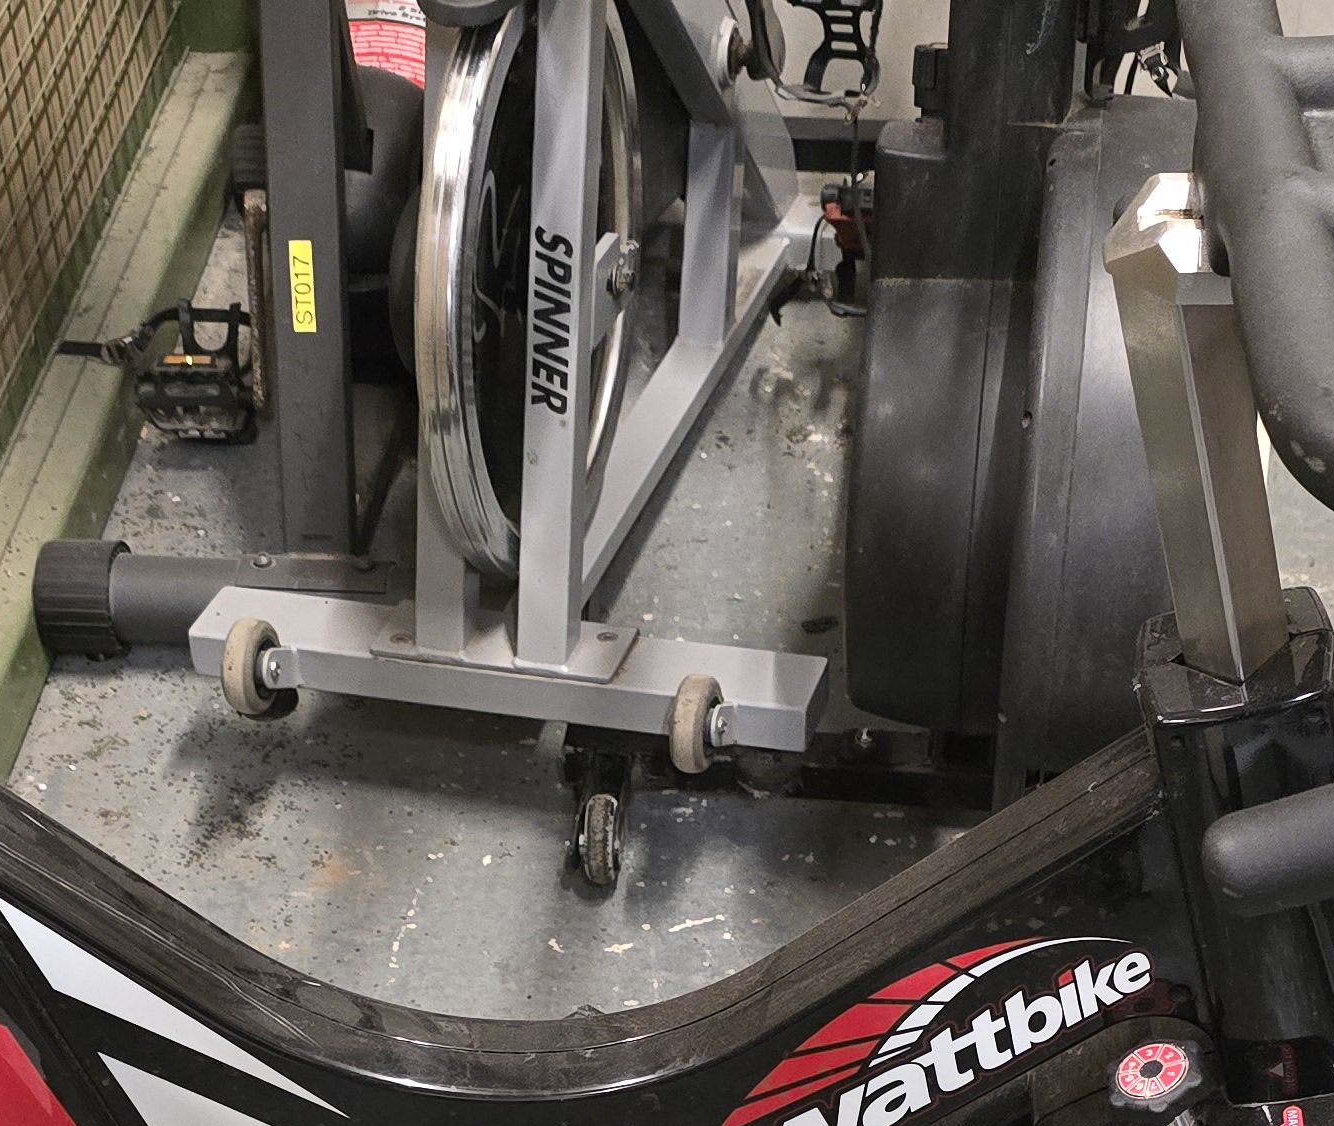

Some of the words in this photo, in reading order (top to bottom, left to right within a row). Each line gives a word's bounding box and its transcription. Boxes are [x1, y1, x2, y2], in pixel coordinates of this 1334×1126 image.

[292, 255, 314, 325] ST017
[531, 226, 573, 416] SPINNER
[1145, 1049, 1154, 1057] 3
[1164, 1051, 1175, 1060] 2
[1124, 1075, 1135, 1083] 5
[1135, 1082, 1144, 1091] 6
[1150, 1082, 1158, 1090] 7
